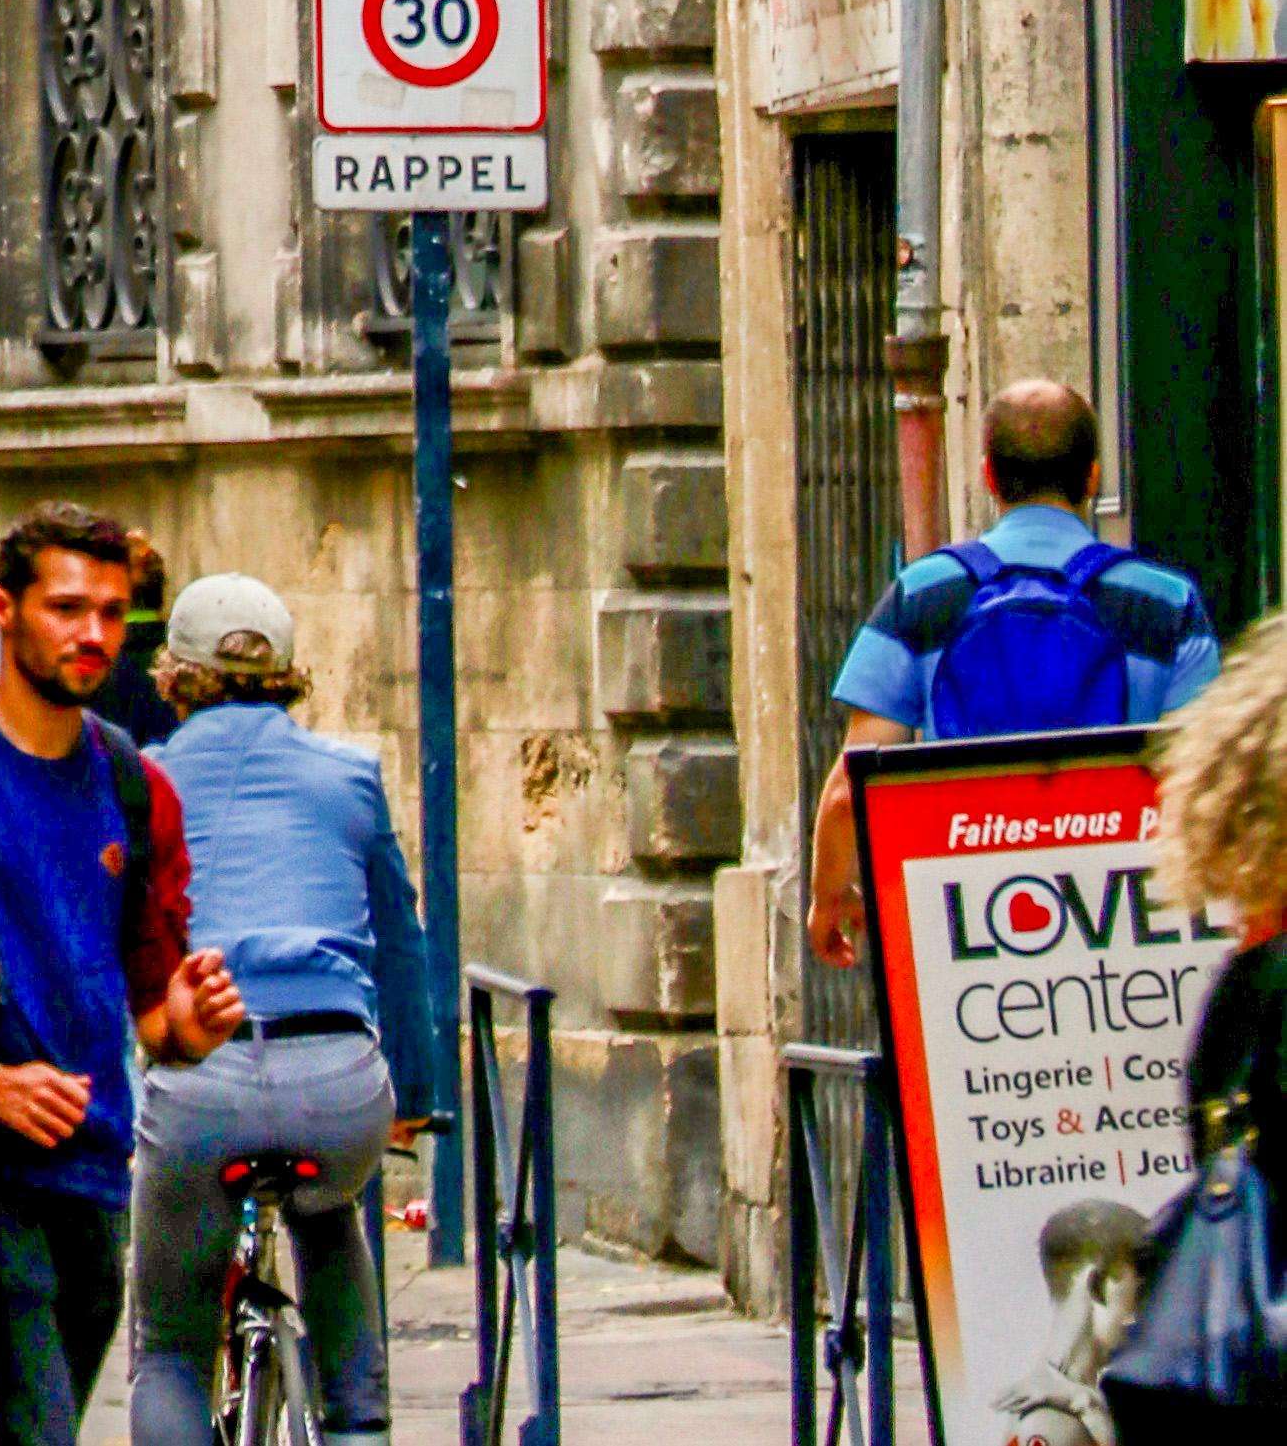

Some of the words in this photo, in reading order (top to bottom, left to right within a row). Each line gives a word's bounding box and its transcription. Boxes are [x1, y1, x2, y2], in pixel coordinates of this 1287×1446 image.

[334, 155, 527, 193] RAPPEL
[948, 811, 1122, 849] Faites-vous
[956, 959, 1198, 1043] center
[964, 1061, 1093, 1099] Lingerie
[968, 1115, 1045, 1147] Toys
[1056, 1108, 1084, 1134] &
[976, 1154, 1106, 1190] Librairie
